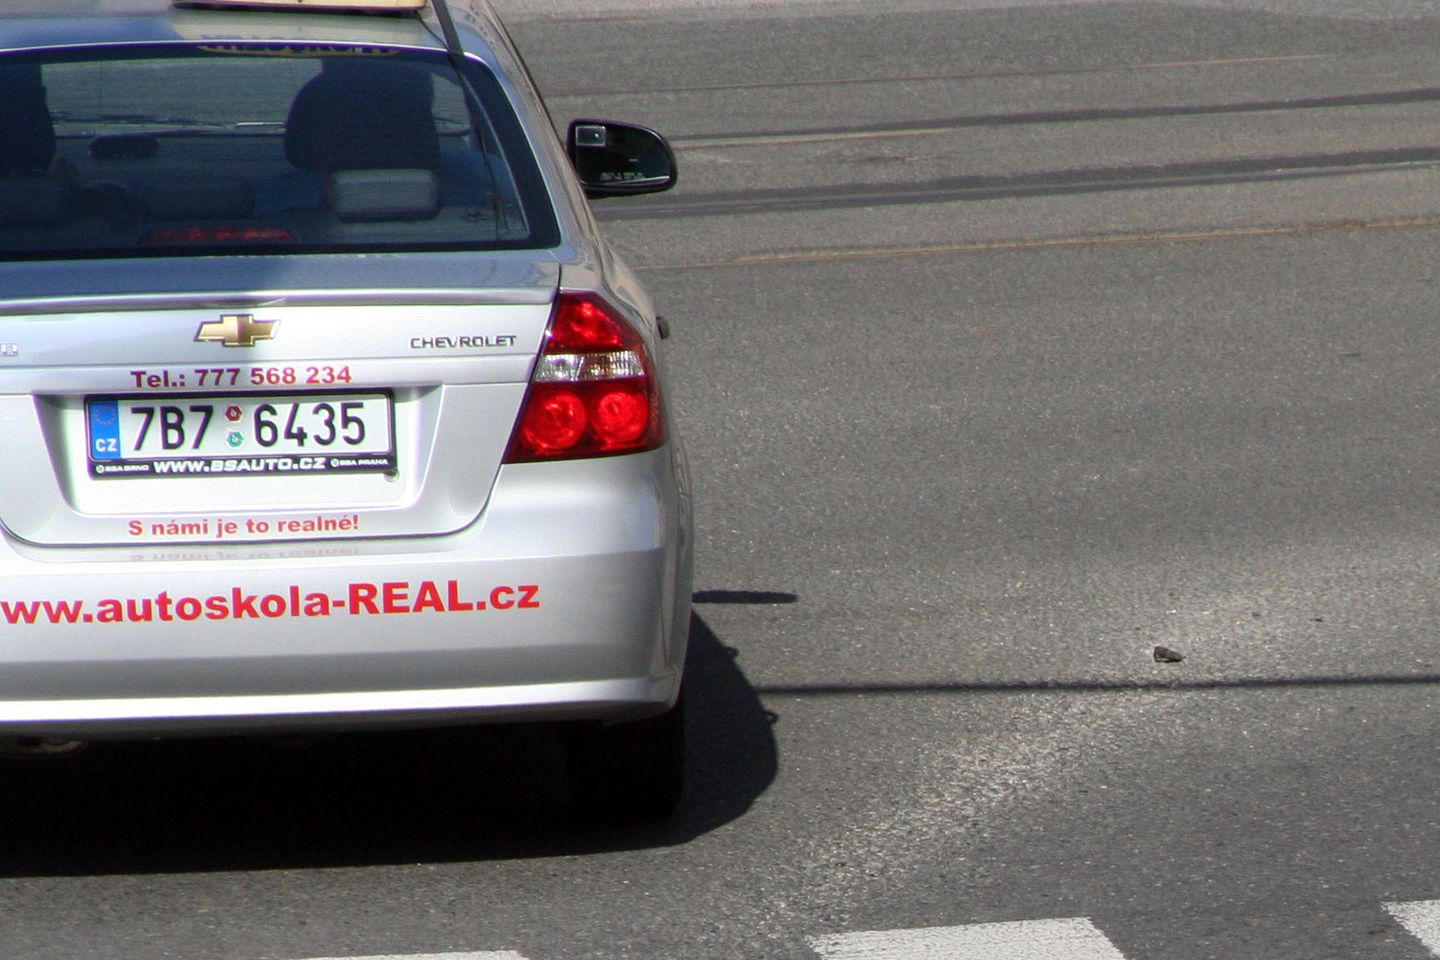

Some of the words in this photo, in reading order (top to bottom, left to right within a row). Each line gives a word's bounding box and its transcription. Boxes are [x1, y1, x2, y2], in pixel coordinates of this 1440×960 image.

[410, 335, 516, 349] CHEVROLET
[130, 370, 186, 388] Tel.:
[194, 368, 240, 386] 777
[250, 367, 296, 385] 568
[305, 366, 352, 384] 234
[130, 405, 213, 451] 7B7
[254, 402, 365, 447] 6435
[95, 438, 117, 452] CZ
[153, 457, 326, 474] WWW.BSAUTO.CZ
[128, 520, 143, 536] S
[152, 519, 208, 536] námi
[216, 518, 238, 538] je
[246, 518, 269, 533] to
[277, 514, 359, 533] realné!
